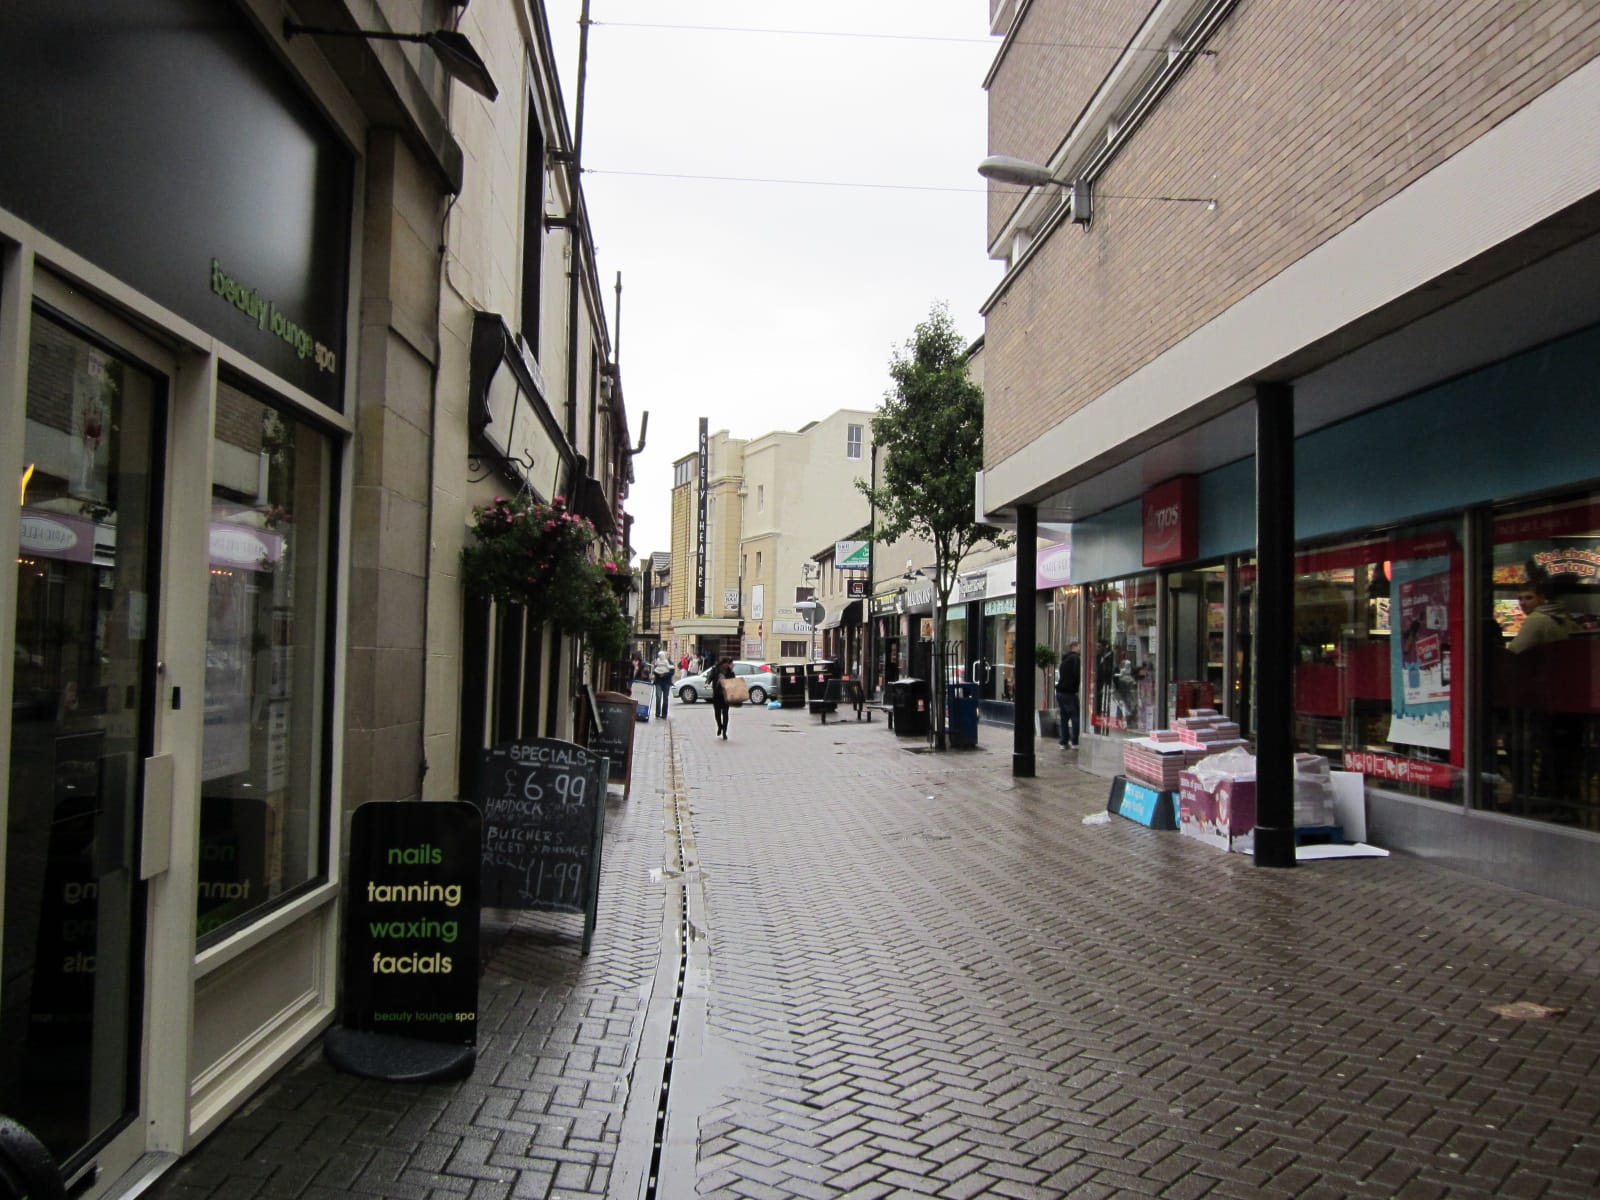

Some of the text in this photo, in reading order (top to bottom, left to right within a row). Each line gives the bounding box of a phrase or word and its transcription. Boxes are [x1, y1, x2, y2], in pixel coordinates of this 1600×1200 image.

[210, 258, 336, 374] beauty lounge spa
[486, 798, 544, 816] HADDOCK
[487, 826, 564, 845] BUTCHERS
[388, 844, 443, 865] nails
[366, 881, 462, 907] tanning
[369, 916, 460, 943] waxing
[371, 952, 453, 975] facials
[374, 1010, 476, 1023] beauty lounge spa
